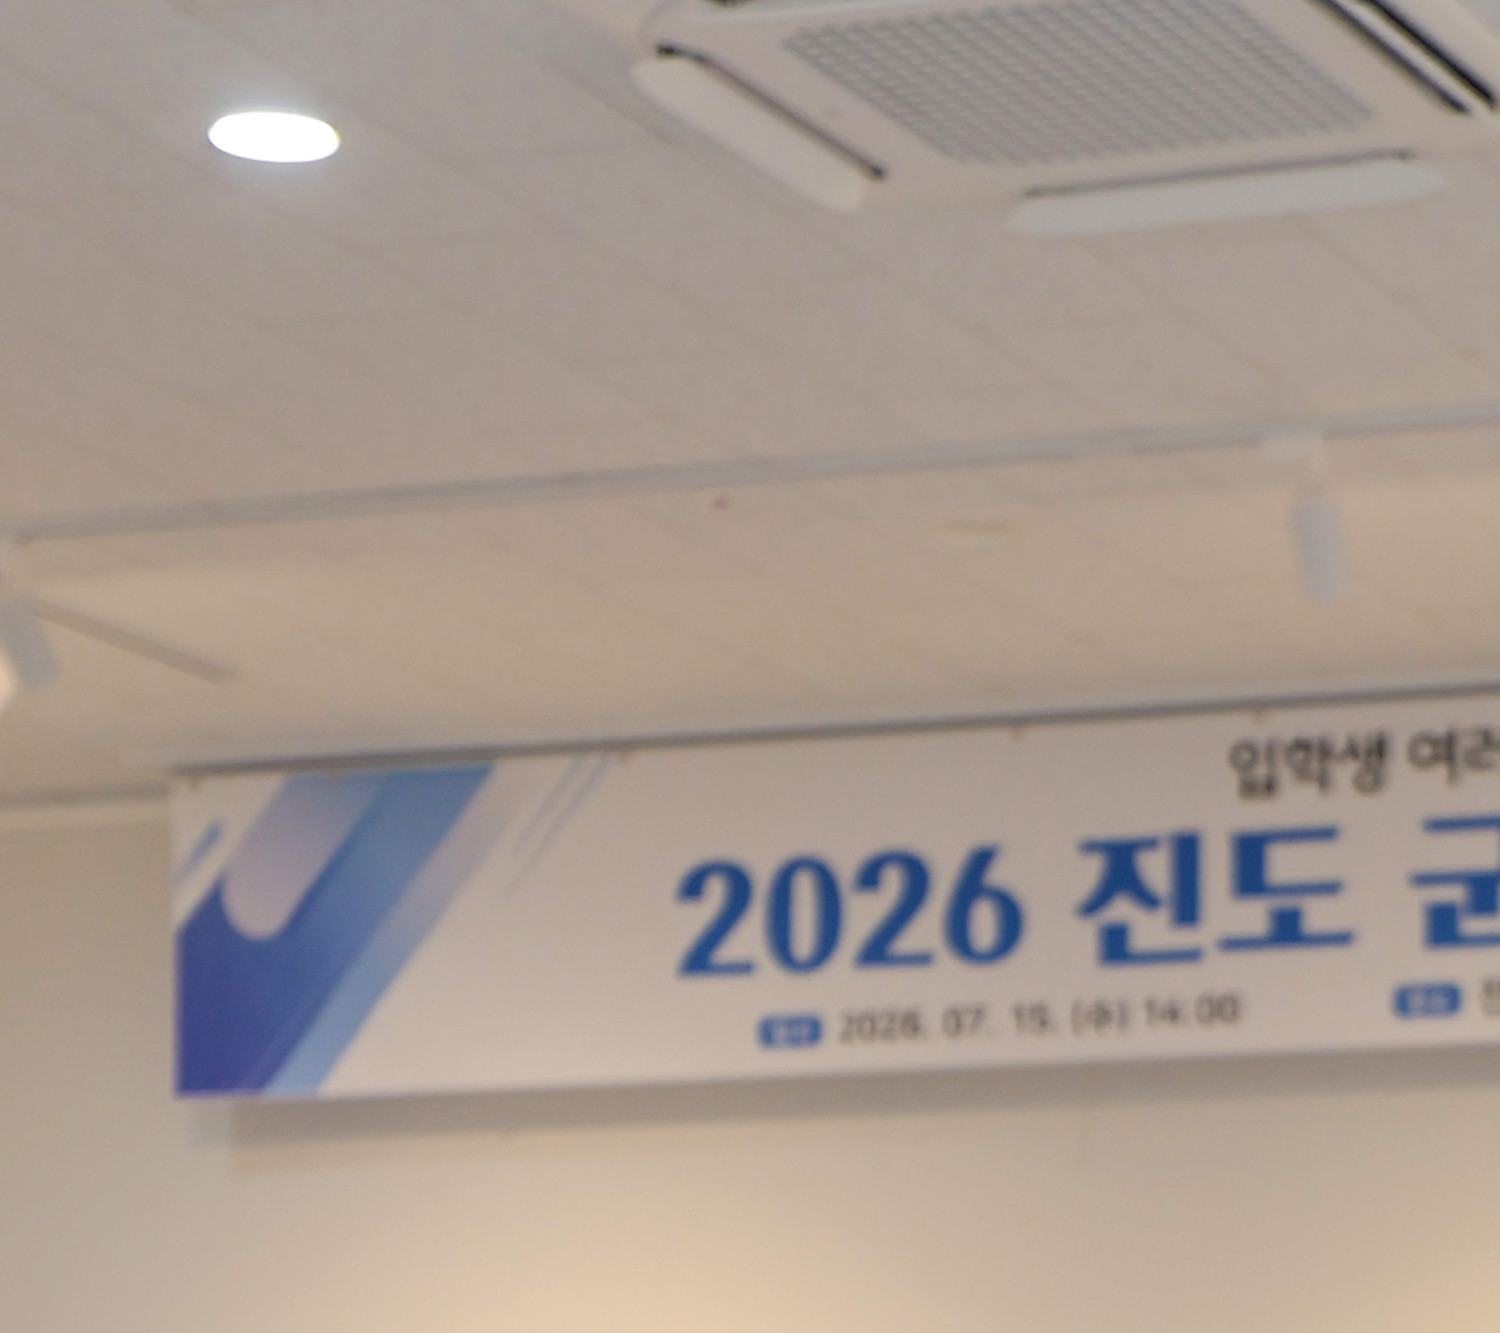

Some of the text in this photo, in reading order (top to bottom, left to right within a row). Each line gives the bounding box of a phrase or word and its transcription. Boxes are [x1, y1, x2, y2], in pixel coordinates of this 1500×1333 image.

[1228, 730, 1388, 801] 입학생
[676, 844, 1026, 978] 2026
[1077, 826, 1357, 969] 진도
